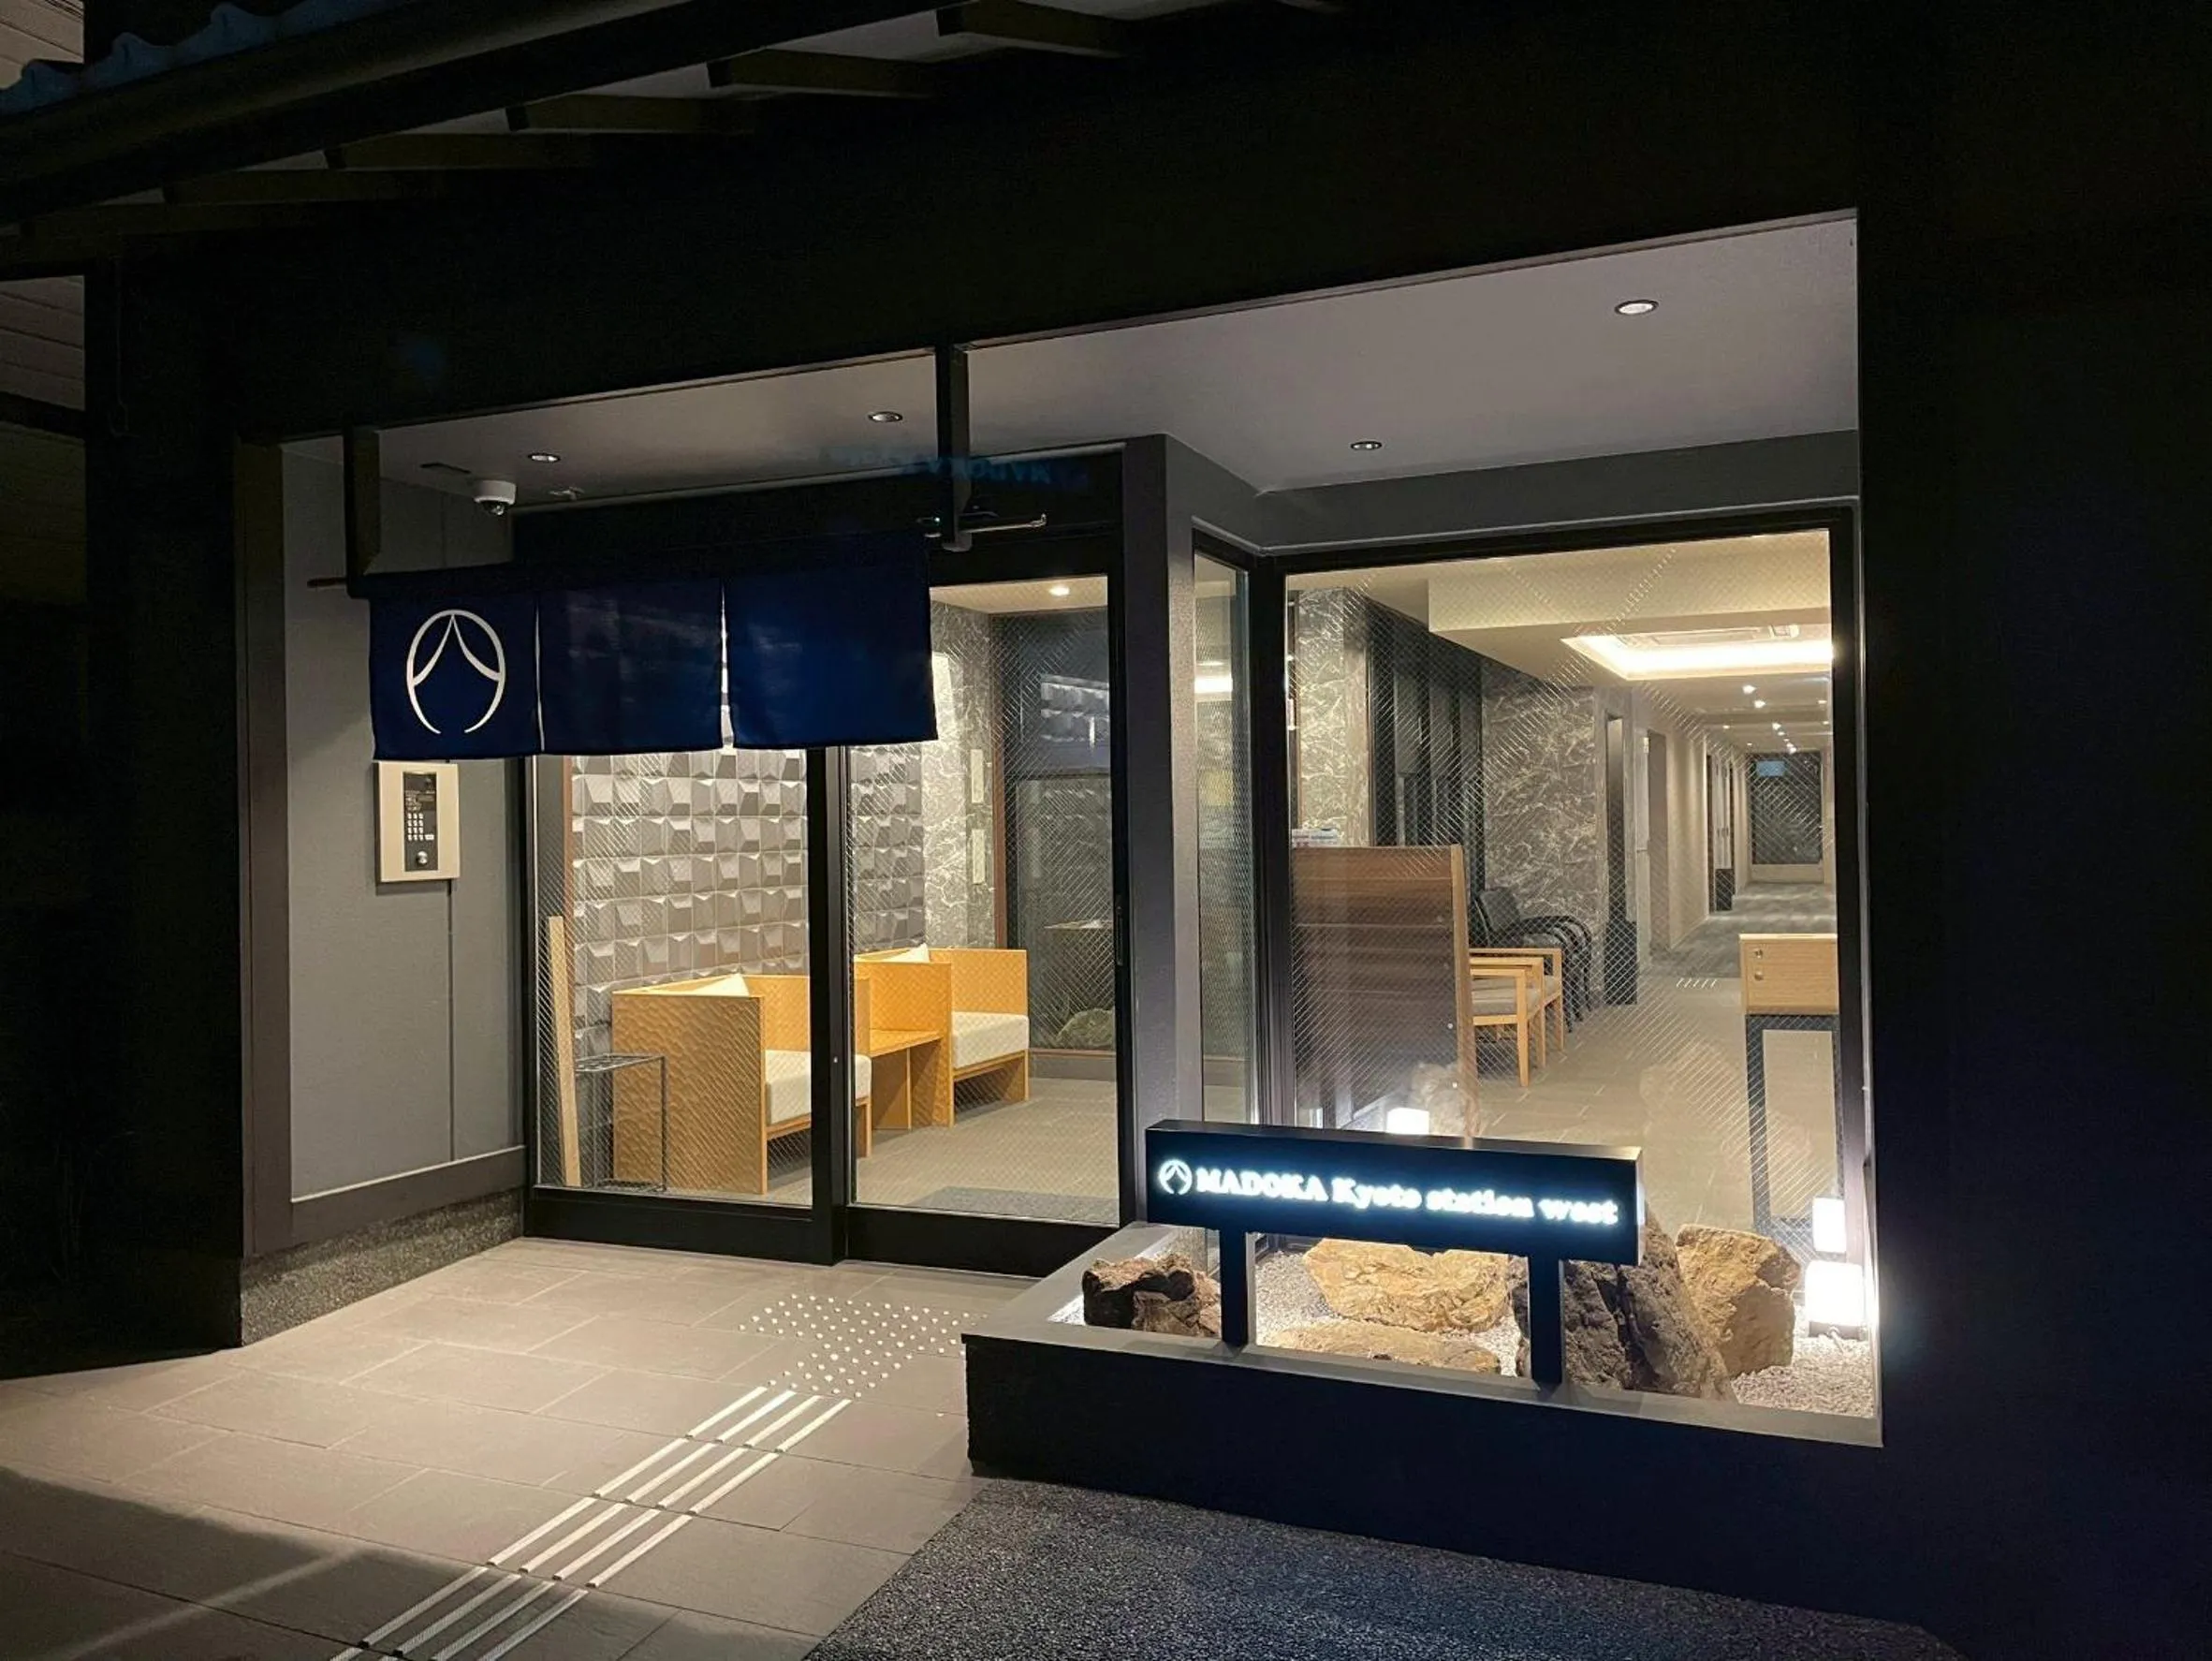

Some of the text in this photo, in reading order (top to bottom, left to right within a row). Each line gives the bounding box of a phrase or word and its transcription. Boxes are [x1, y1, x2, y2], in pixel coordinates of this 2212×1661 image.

[1195, 1167, 1619, 1227] MADOKA Kyoto station west
